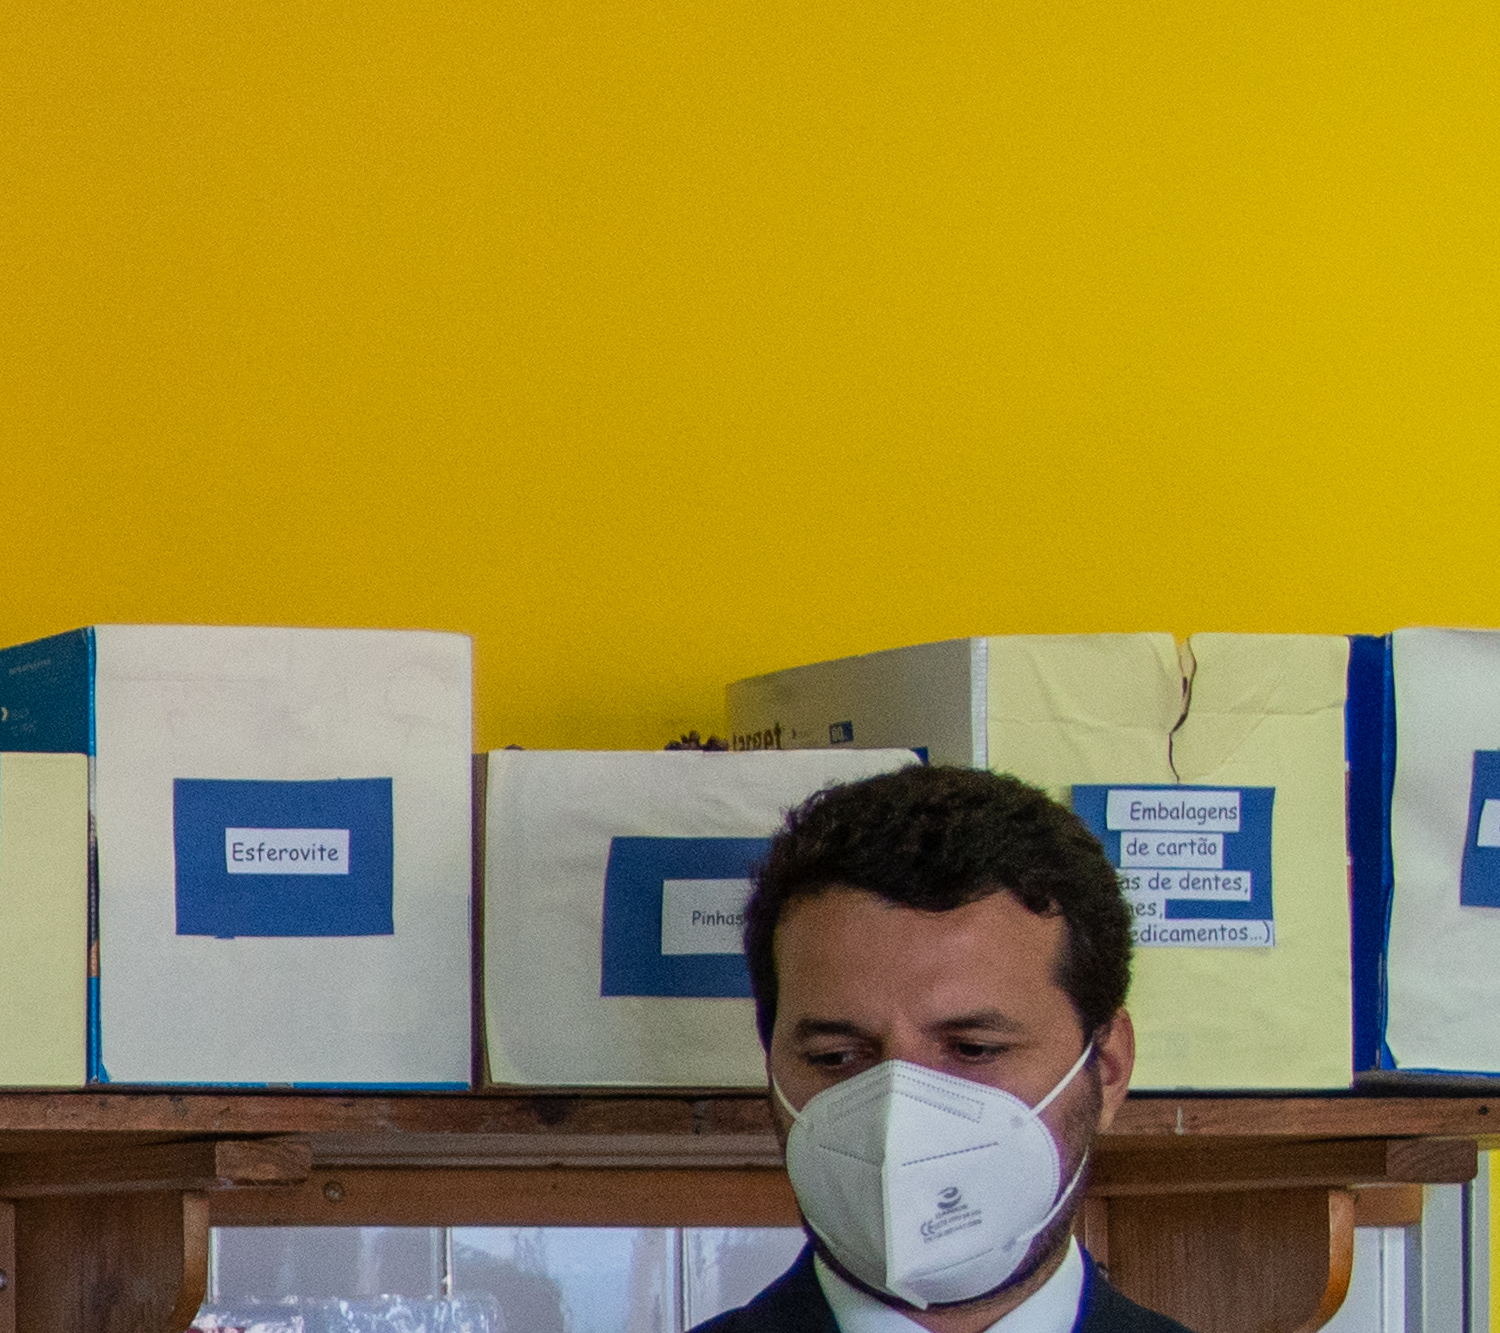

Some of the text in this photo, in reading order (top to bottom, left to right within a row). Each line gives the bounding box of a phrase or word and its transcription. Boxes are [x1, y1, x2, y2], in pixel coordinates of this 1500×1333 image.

[1129, 800, 1238, 825] Embalagens
[231, 840, 339, 866] Esferovite
[1125, 836, 1217, 856] de cartão
[1147, 872, 1173, 891] de
[1178, 872, 1249, 894] dentes,
[1131, 920, 1271, 943] edicamentos...)
